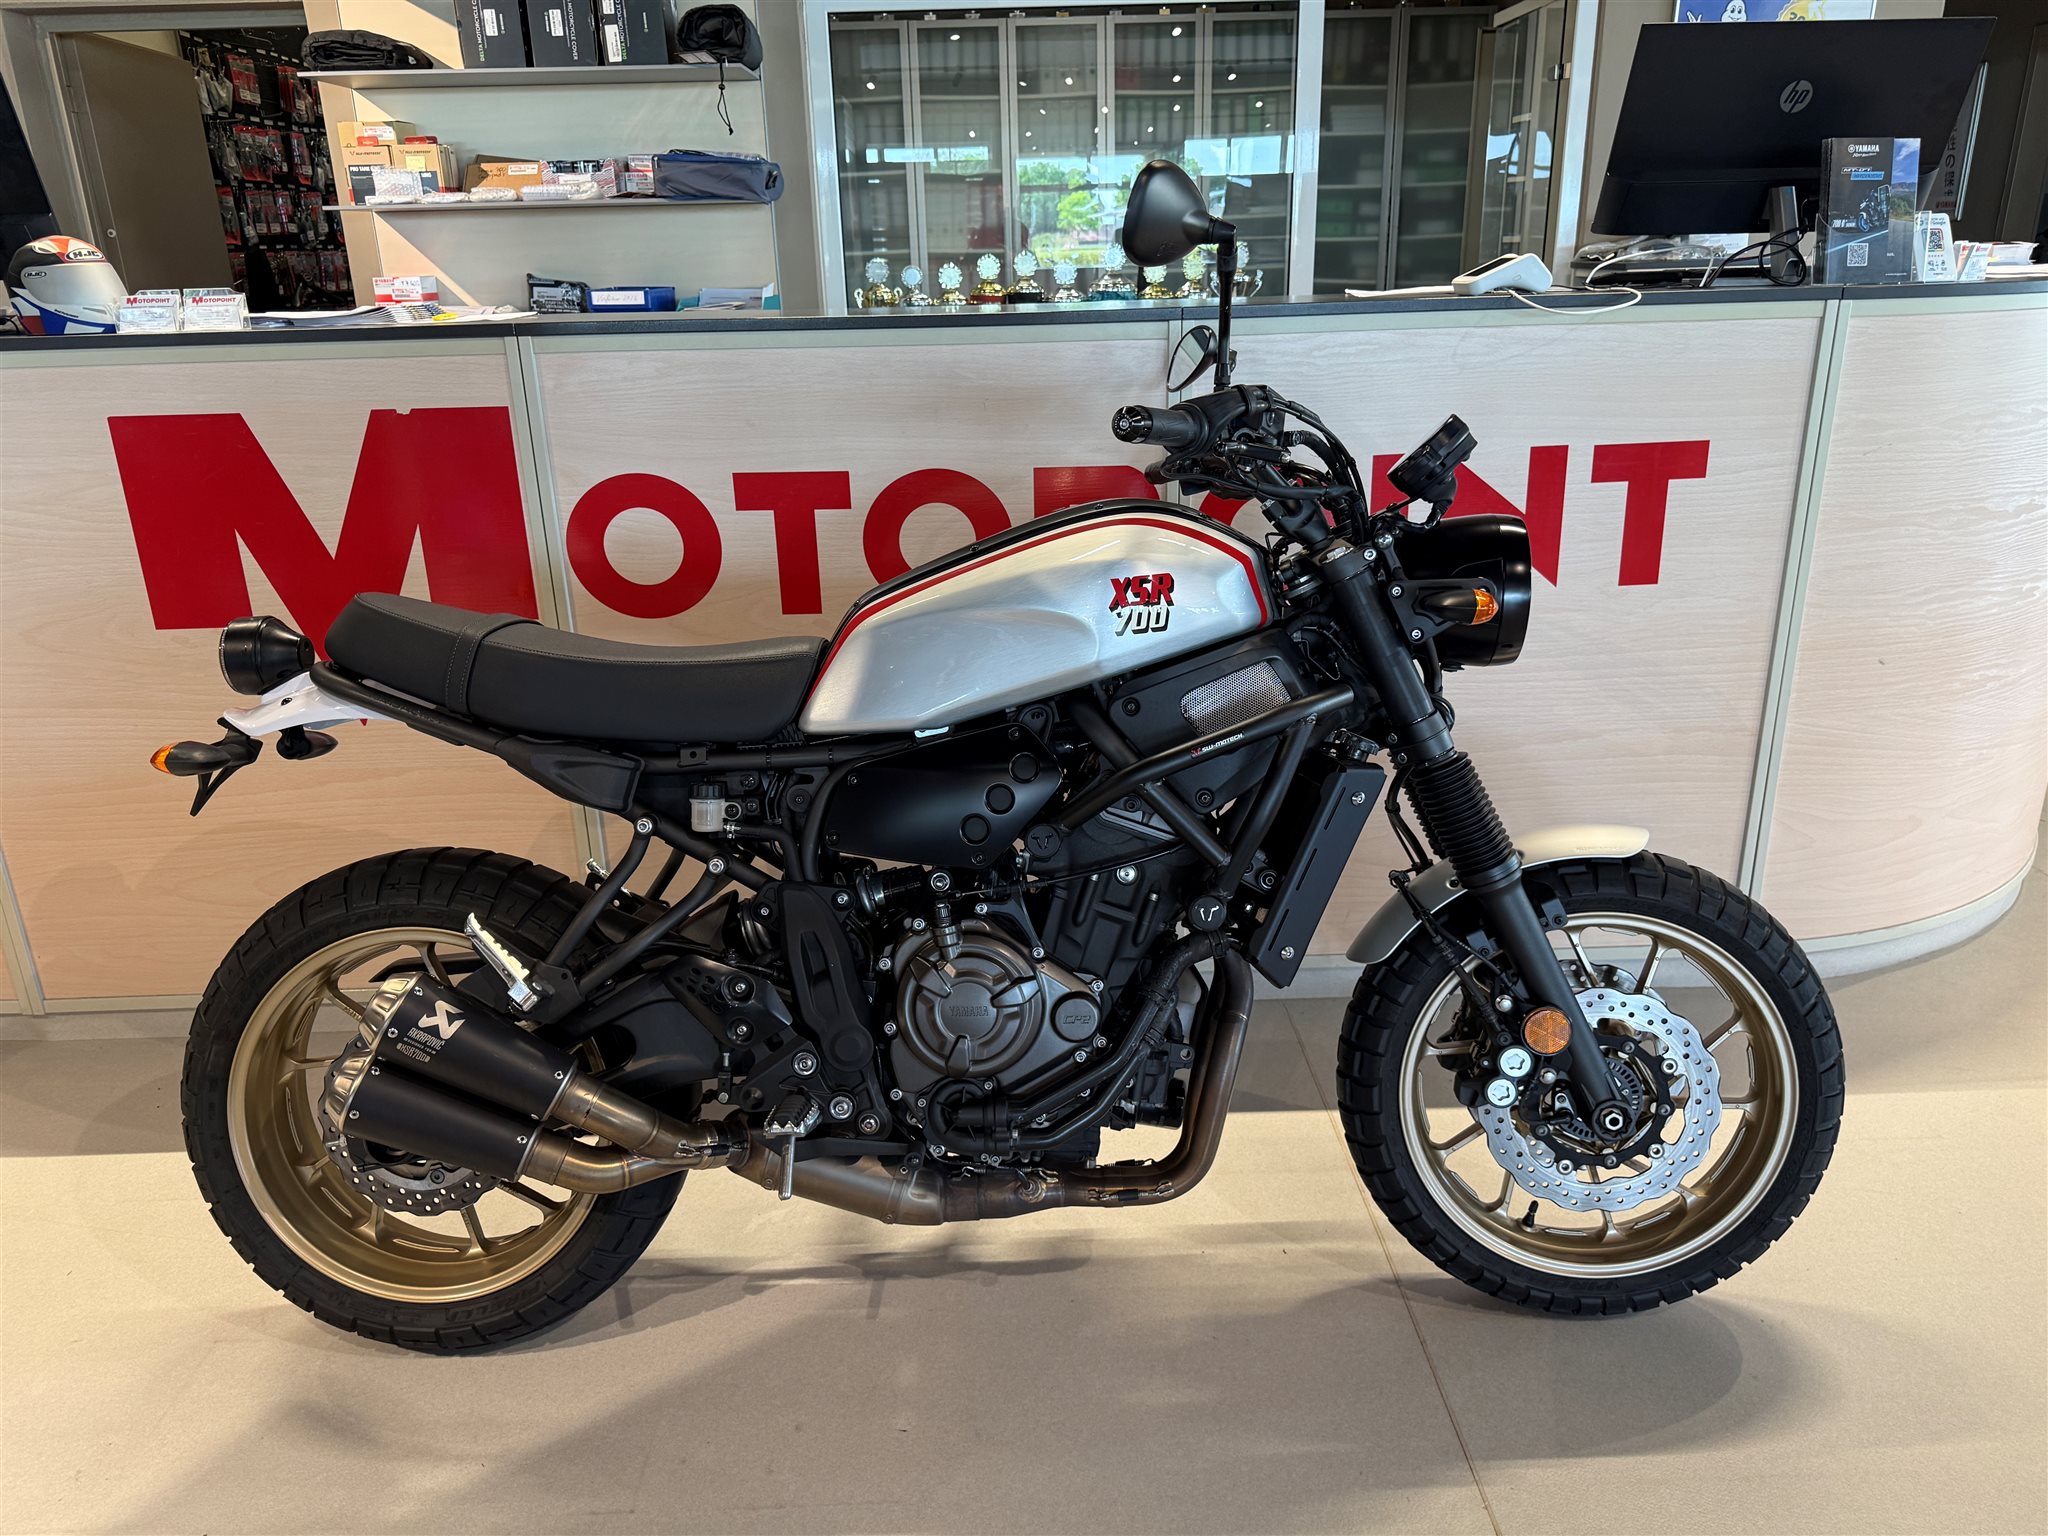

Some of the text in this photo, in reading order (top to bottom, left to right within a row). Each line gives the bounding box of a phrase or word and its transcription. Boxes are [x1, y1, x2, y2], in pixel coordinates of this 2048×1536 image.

[473, 5, 483, 44] MOTORCYCLE
[567, 2, 579, 61] MOTORCYCLE COVER
[617, 4, 625, 42] MOTORCYCLE
[1783, 80, 1811, 113] hp
[1854, 144, 1880, 153] YAMAHA
[72, 250, 100, 259] HJC
[126, 297, 171, 307] MOTOPOINT
[192, 297, 237, 306] MOTOPOINT
[107, 405, 1711, 662] MOTONT
[1109, 572, 1175, 612] XSR
[1112, 605, 1171, 637] 700
[1201, 732, 1244, 753] SW-MOTECH
[949, 1006, 989, 1017] YAMAHA
[1062, 1014, 1092, 1025] CP2
